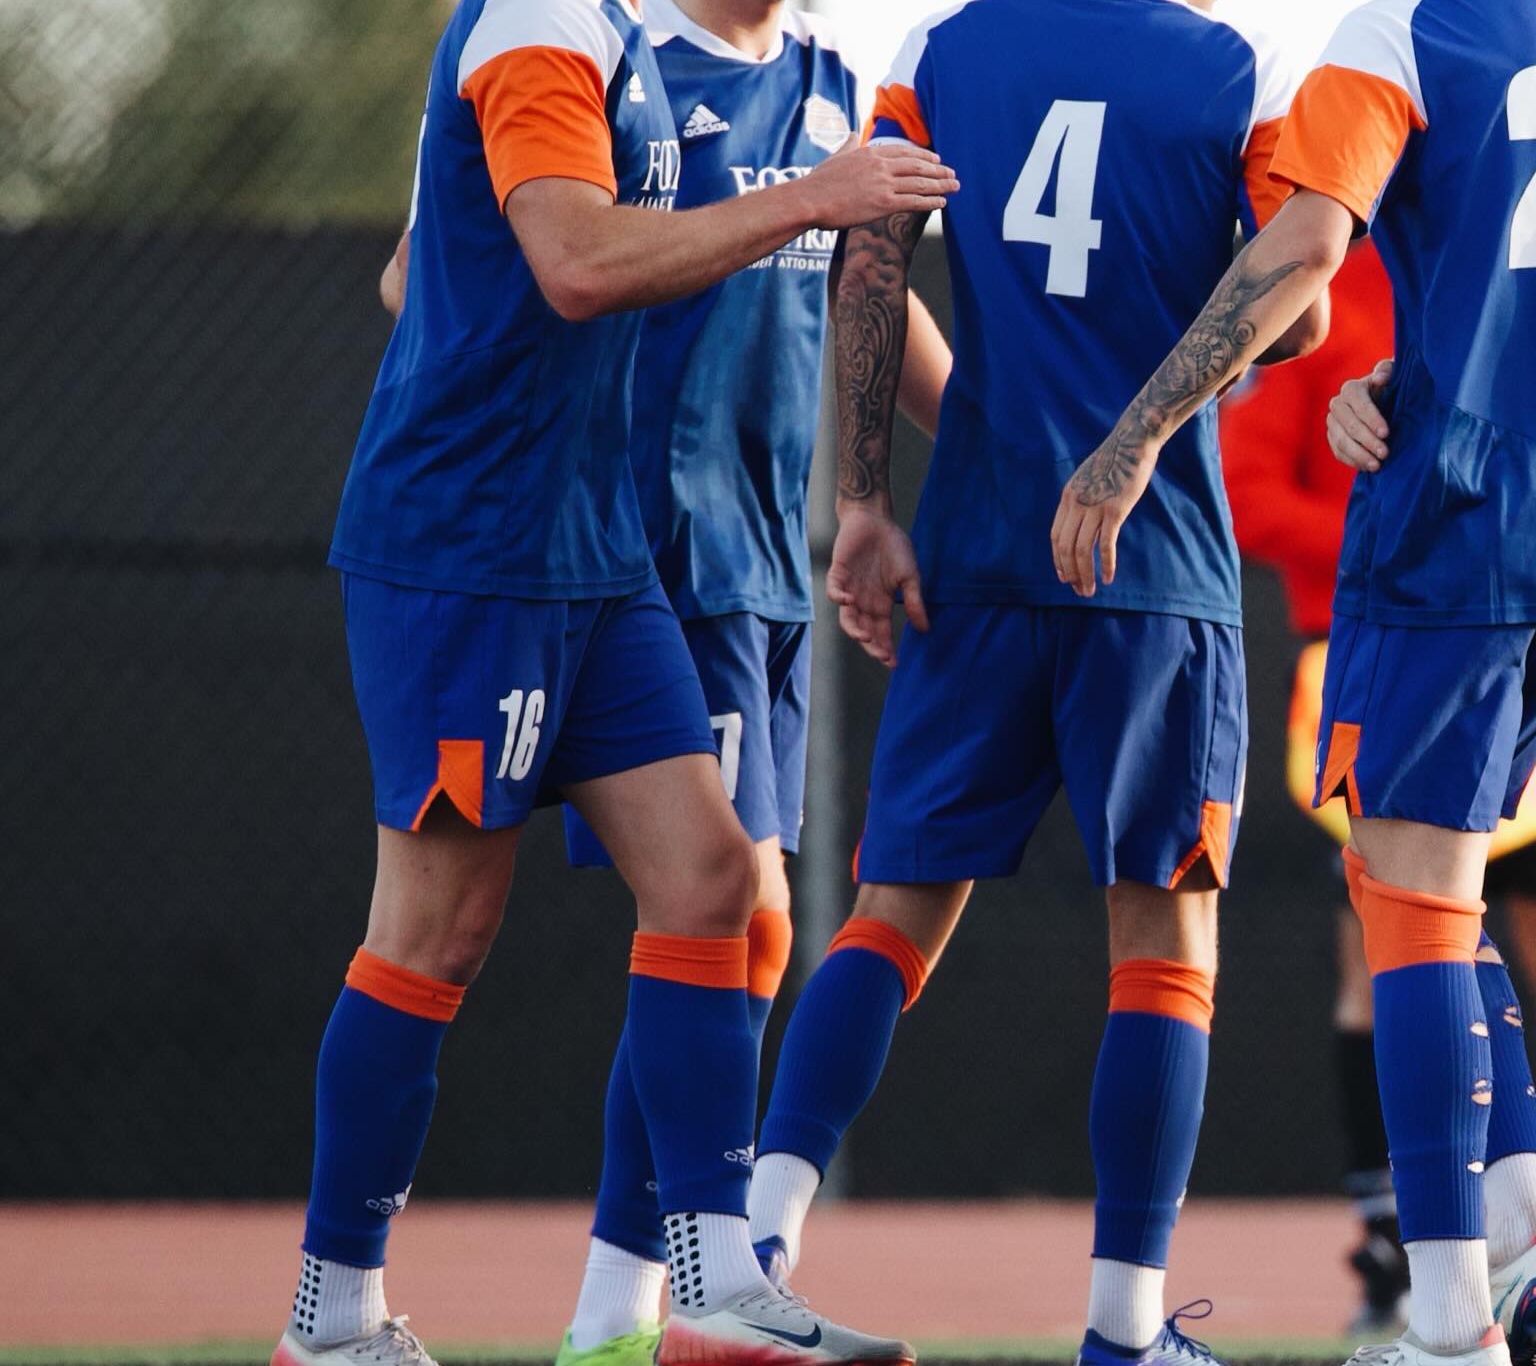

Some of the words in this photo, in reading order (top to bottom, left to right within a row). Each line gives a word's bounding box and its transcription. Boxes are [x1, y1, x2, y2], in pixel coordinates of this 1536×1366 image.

[683, 121, 730, 138] adidas
[1002, 100, 1107, 298] 4
[495, 689, 546, 781] 16
